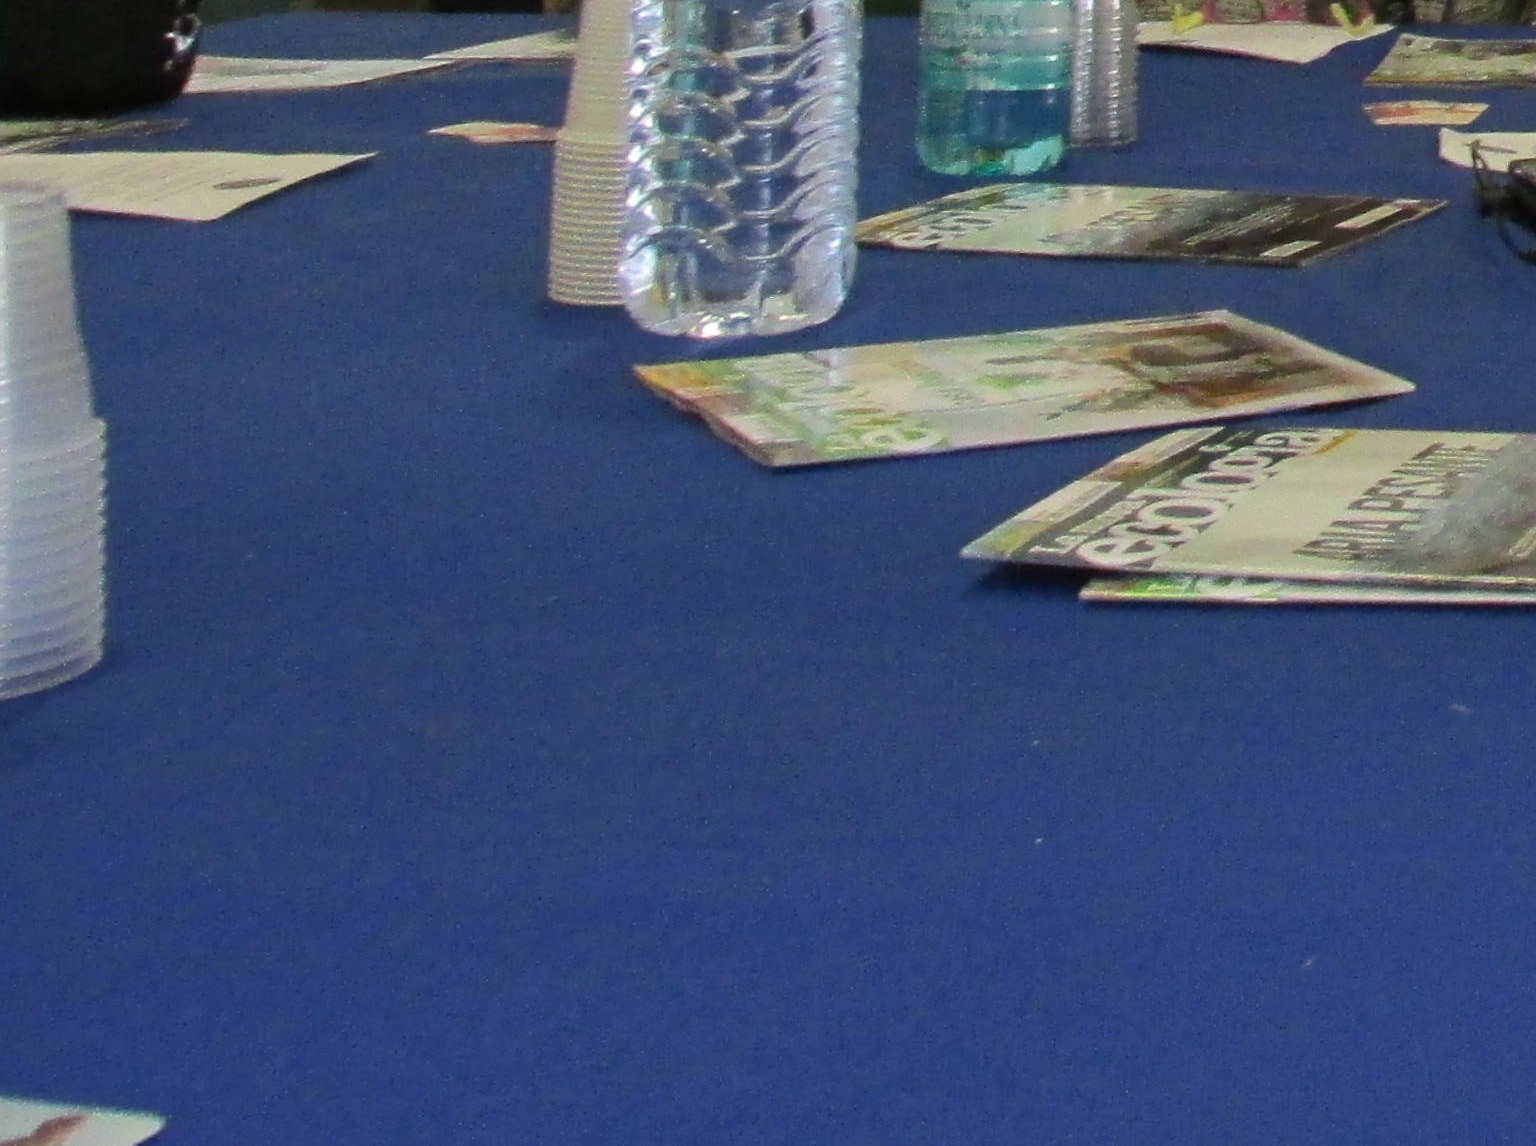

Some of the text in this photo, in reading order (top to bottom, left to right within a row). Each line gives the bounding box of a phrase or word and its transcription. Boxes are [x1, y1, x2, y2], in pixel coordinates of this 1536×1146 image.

[1075, 430, 1328, 568] ecologia
[1346, 442, 1505, 514] PESANTE
[1291, 518, 1425, 560] ARIA
